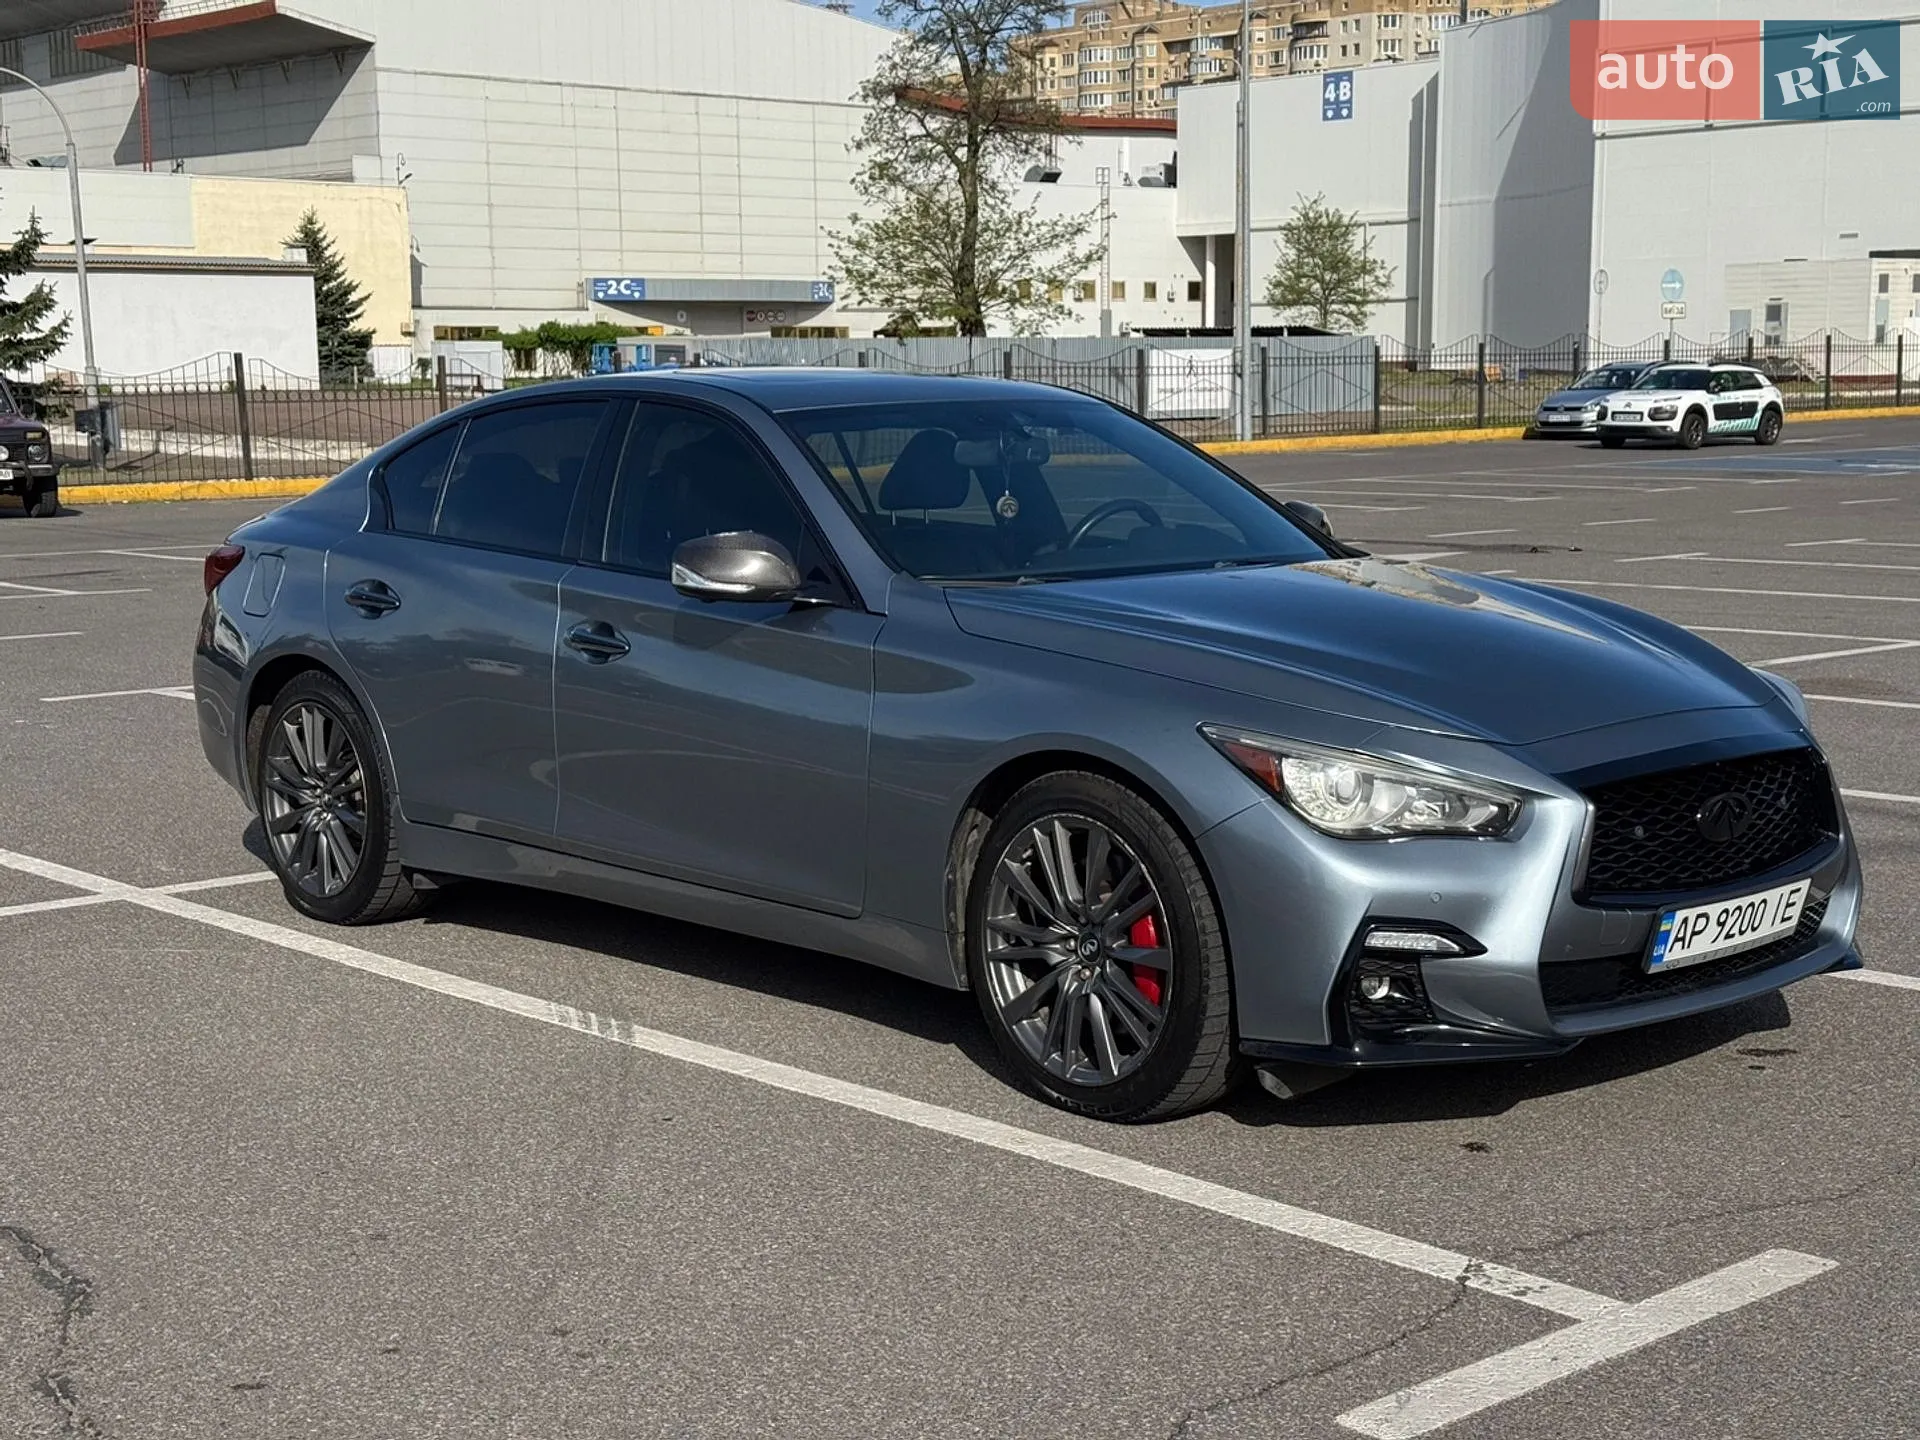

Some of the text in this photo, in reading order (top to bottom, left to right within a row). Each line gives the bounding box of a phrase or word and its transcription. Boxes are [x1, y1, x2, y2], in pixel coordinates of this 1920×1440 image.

[1668, 911, 1711, 953] AP
[1710, 898, 1768, 944] 9200
[1771, 887, 1802, 927] IE
